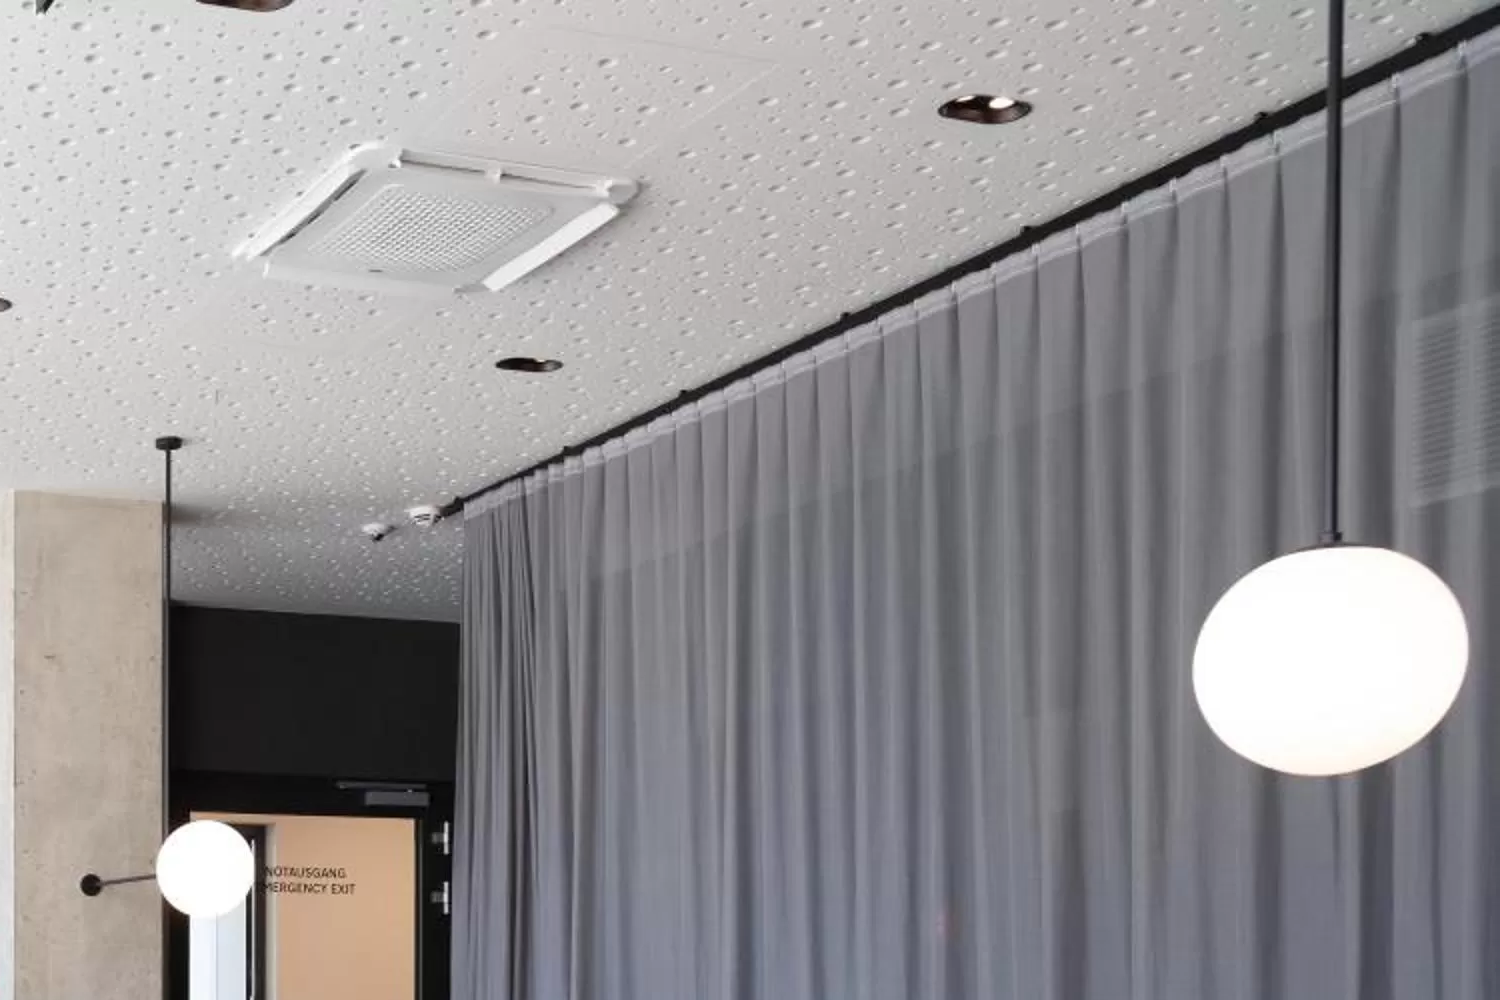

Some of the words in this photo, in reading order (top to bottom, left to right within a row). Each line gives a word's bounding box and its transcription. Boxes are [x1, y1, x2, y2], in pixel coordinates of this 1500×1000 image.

[264, 866, 348, 879] NOTAUSGANG
[257, 881, 327, 894] MERGENCY
[331, 883, 356, 895] EXIT
